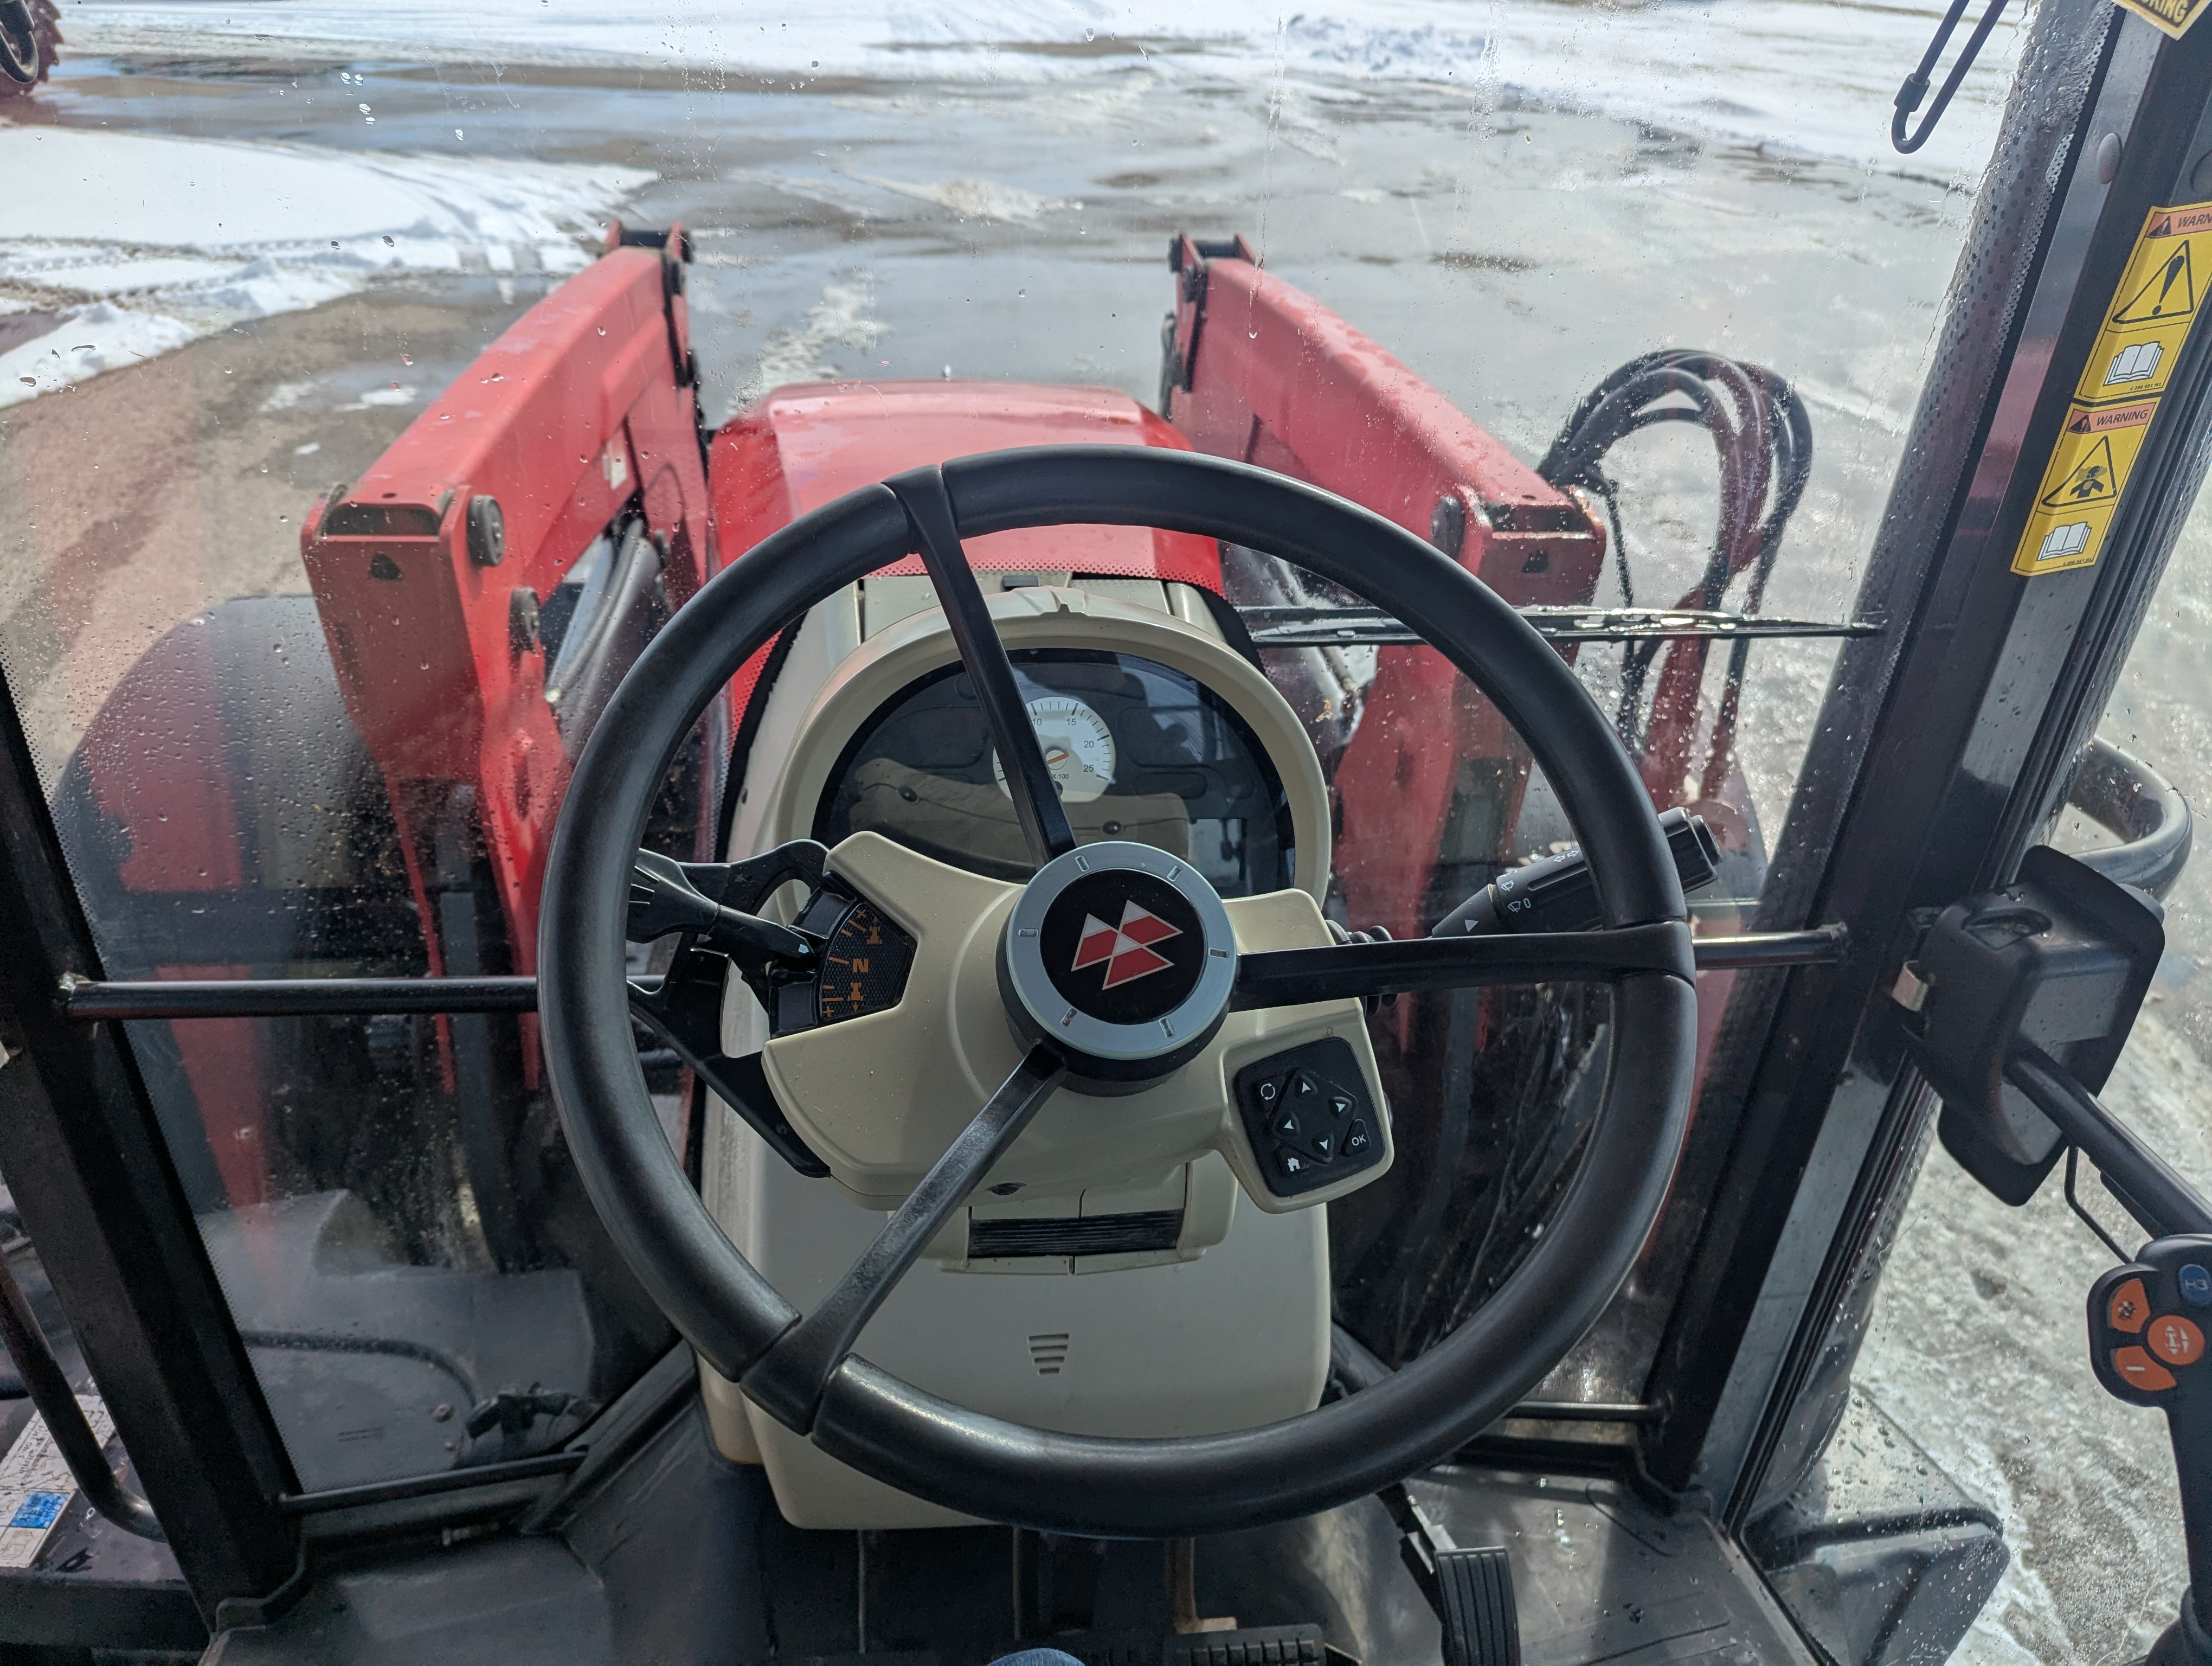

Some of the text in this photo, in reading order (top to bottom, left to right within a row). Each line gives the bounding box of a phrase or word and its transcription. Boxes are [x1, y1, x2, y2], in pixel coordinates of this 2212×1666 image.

[2097, 409, 2149, 426] WARNING
[1083, 764, 1094, 772] 25
[852, 958, 869, 973] N
[1352, 1134, 1366, 1146] OK
